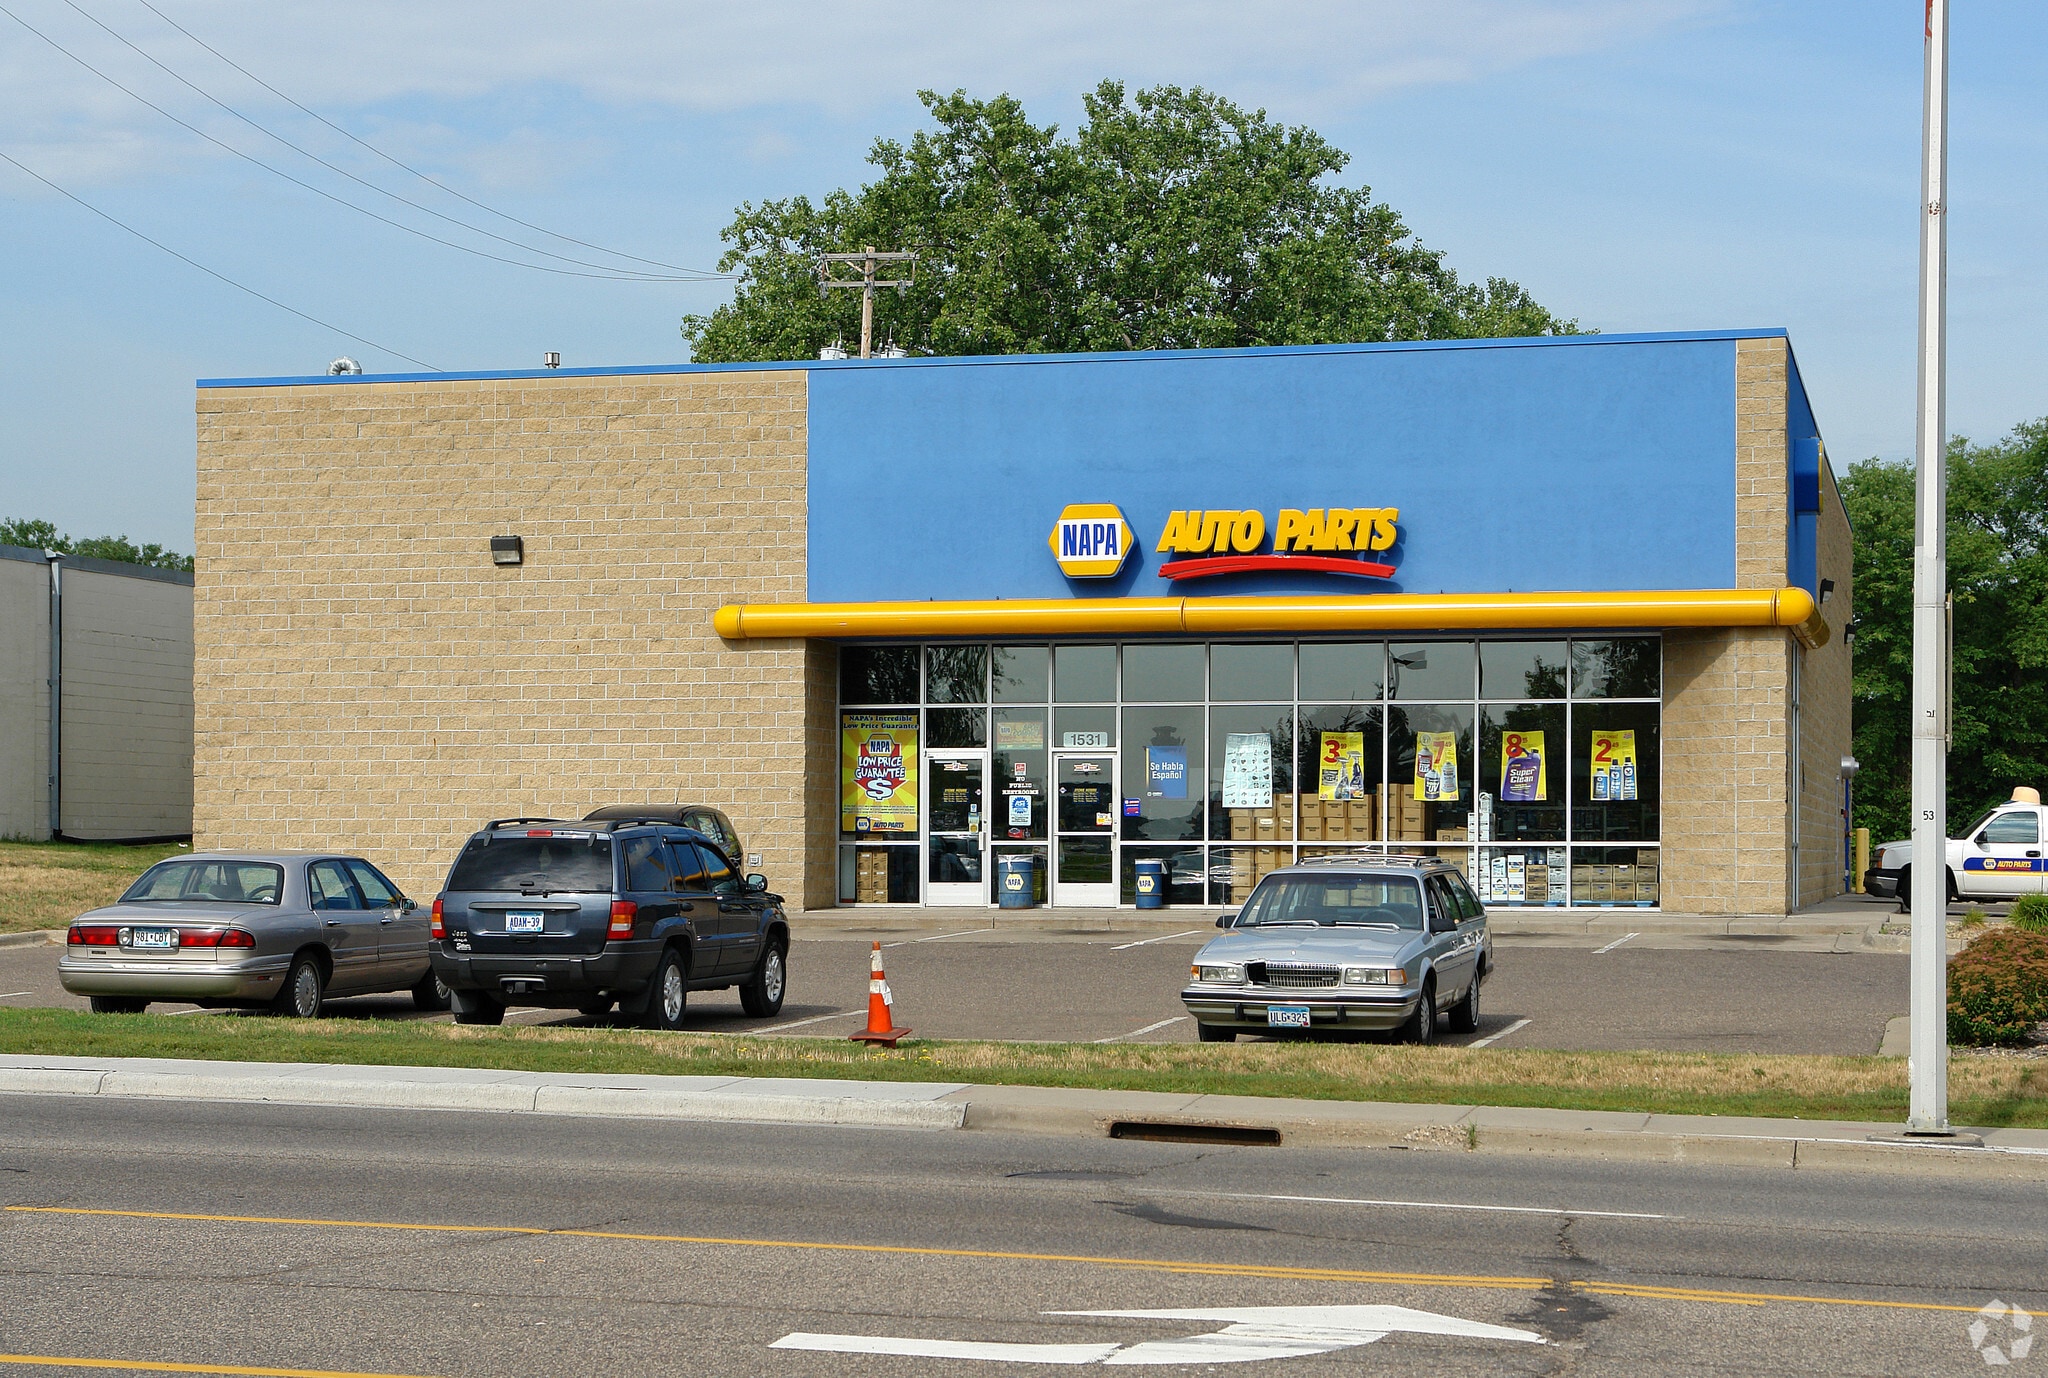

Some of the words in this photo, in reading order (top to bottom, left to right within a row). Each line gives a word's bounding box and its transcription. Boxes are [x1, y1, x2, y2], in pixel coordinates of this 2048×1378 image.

[1156, 509, 1267, 553] AUTO
[1274, 507, 1400, 552] PARTS
[1062, 523, 1118, 556] NAPA
[1070, 733, 1101, 746] 1531
[870, 740, 890, 752] NAPA
[1323, 739, 1341, 764] 3
[1506, 734, 1523, 758] 8
[1594, 738, 1612, 762] 2
[1433, 741, 1445, 764] 7
[858, 756, 877, 767] LOW
[877, 756, 902, 767] PRICE
[1150, 762, 1160, 770] Se
[1161, 761, 1184, 771] Habla
[855, 767, 906, 779] GUARANTEE
[1151, 771, 1183, 780] Español
[1510, 768, 1535, 777] Super
[1922, 810, 1935, 820] 53
[2013, 860, 2032, 868] PARTS
[509, 916, 540, 928] ADAM-39
